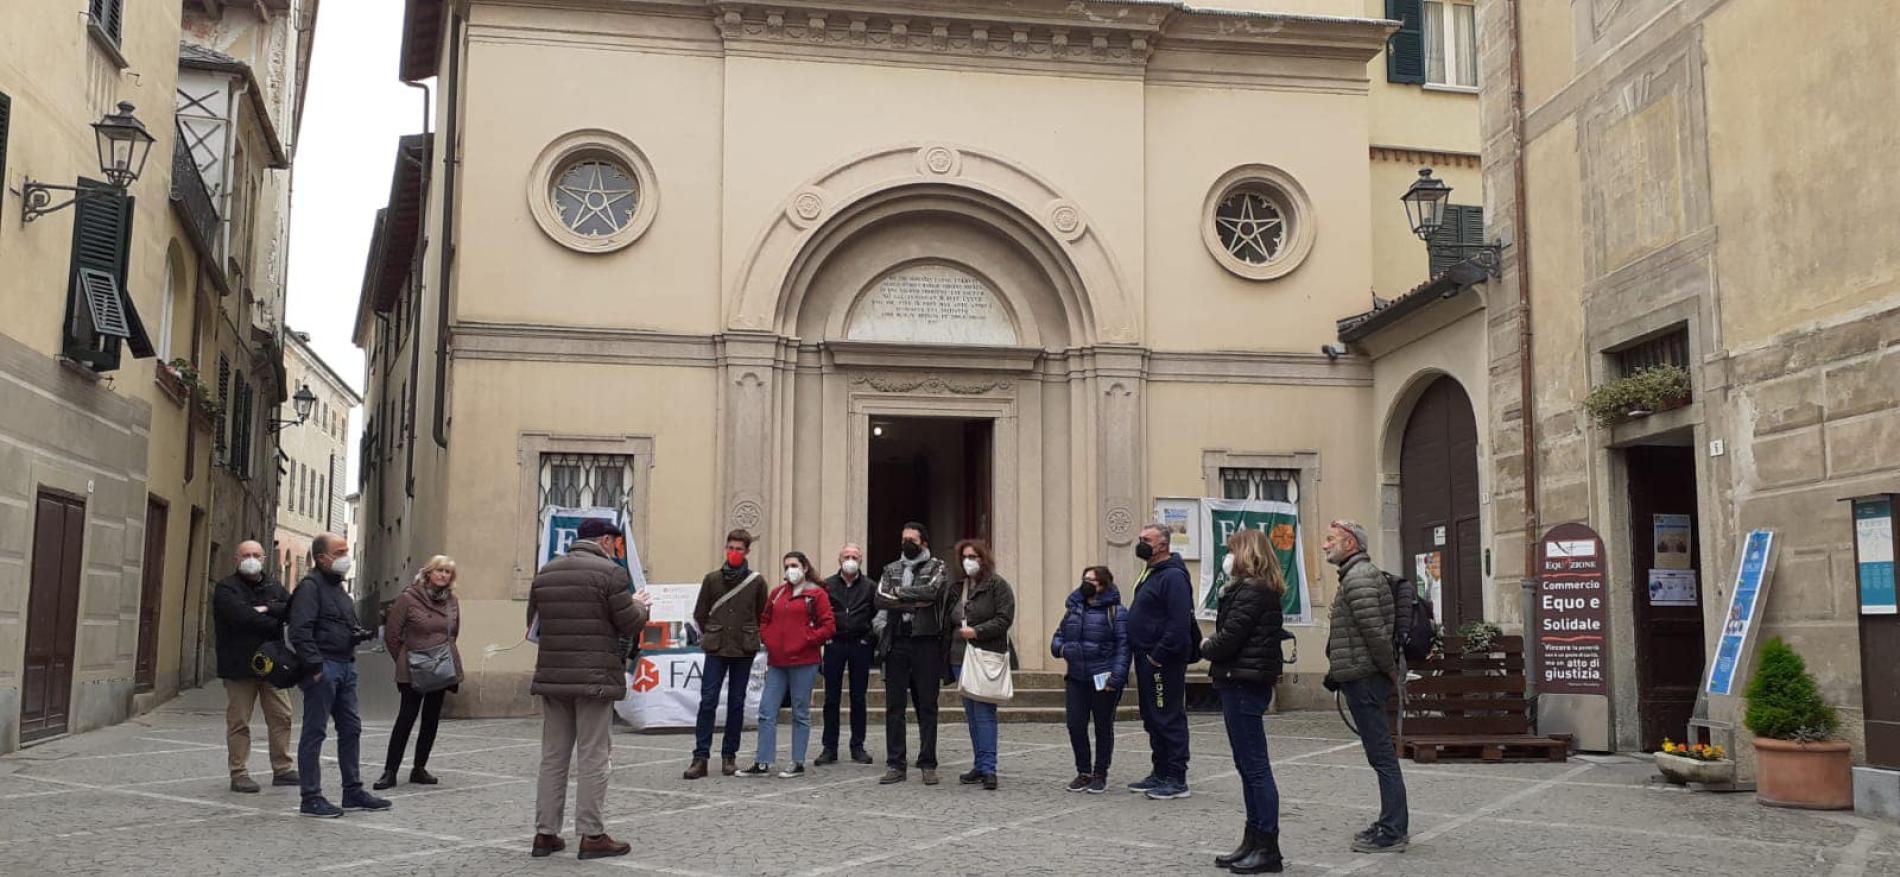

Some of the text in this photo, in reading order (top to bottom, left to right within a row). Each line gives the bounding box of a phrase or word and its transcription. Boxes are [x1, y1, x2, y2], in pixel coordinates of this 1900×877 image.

[1543, 580, 1600, 590] Commercio
[1543, 595, 1600, 612] Equo e
[1543, 618, 1600, 630] Solidale
[1567, 659, 1587, 668] atto
[1590, 658, 1600, 668] di
[670, 661, 704, 688] FA
